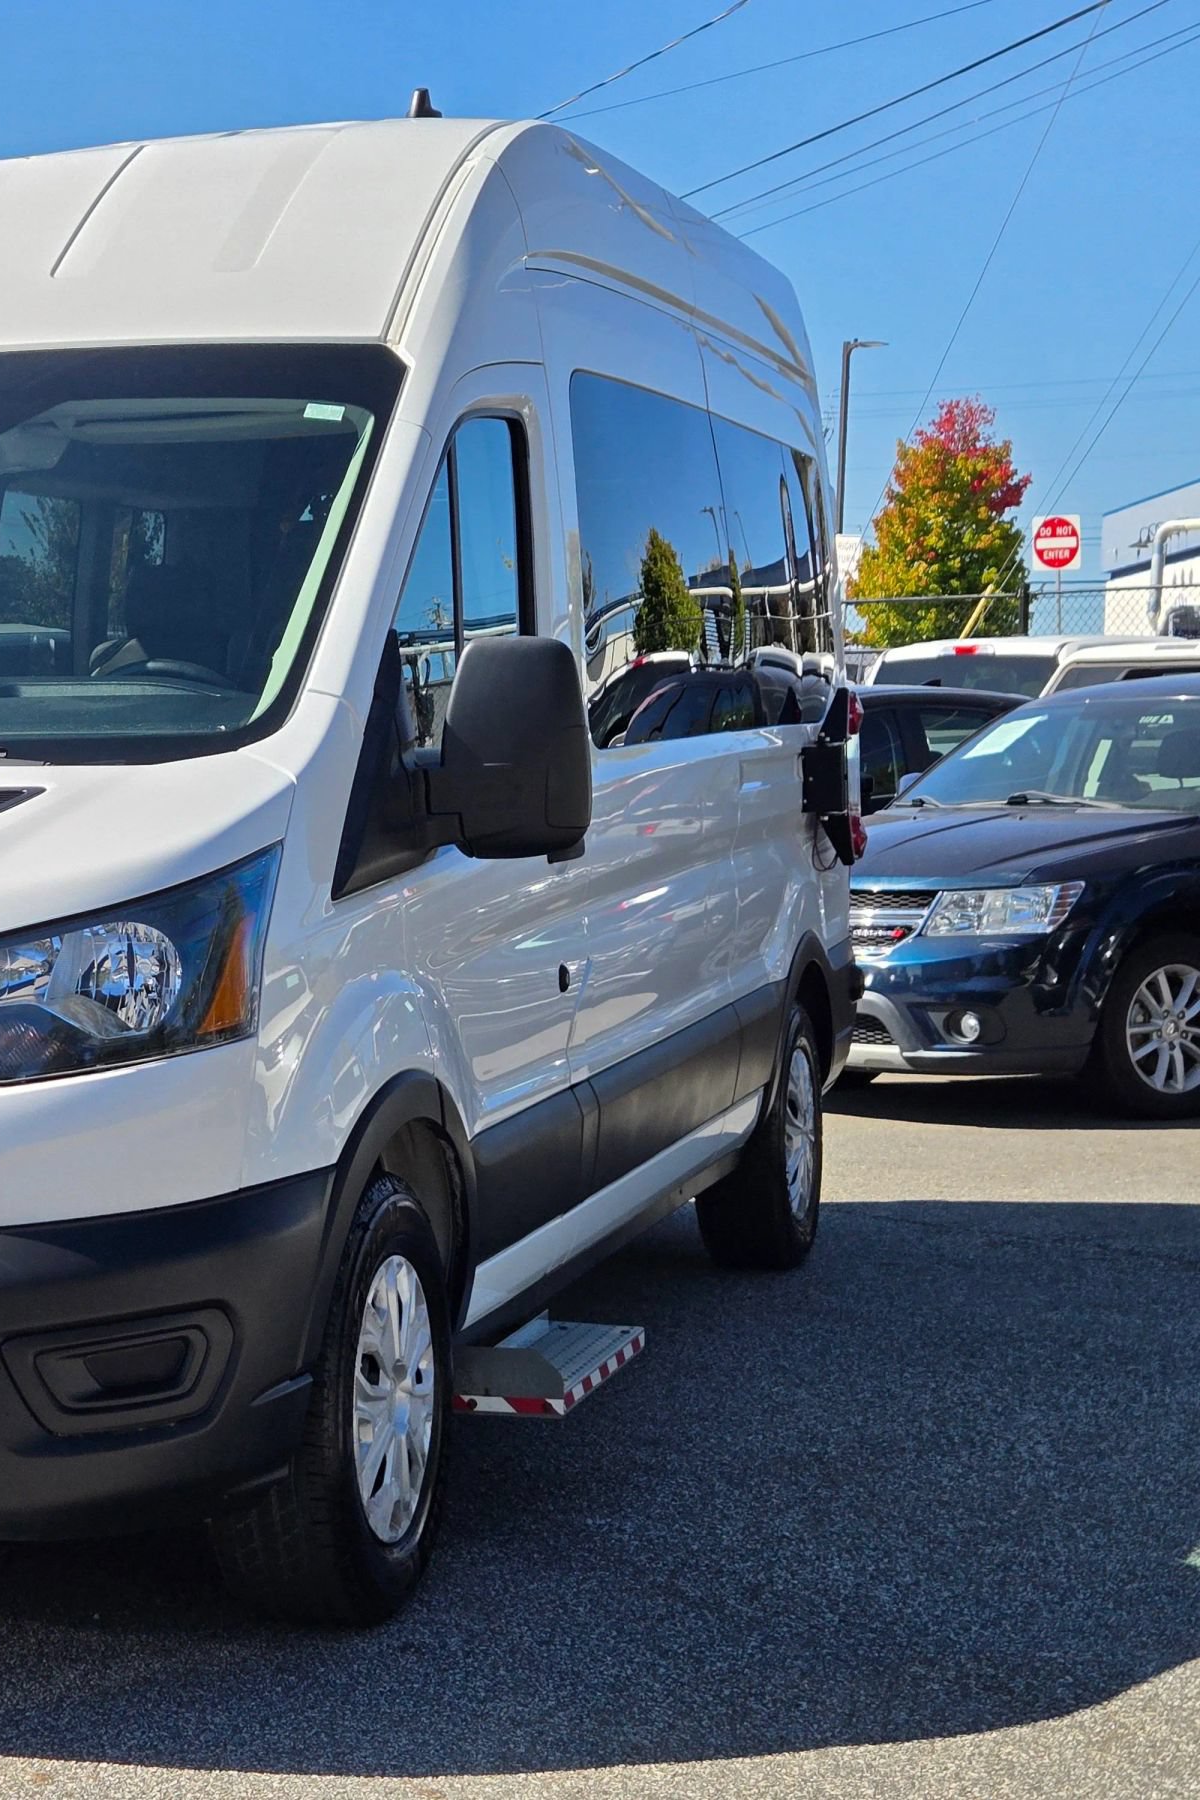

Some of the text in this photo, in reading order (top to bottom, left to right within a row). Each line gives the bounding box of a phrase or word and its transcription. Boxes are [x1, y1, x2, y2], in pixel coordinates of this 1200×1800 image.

[1040, 524, 1073, 537] DO NOT
[1043, 548, 1070, 560] ENTER
